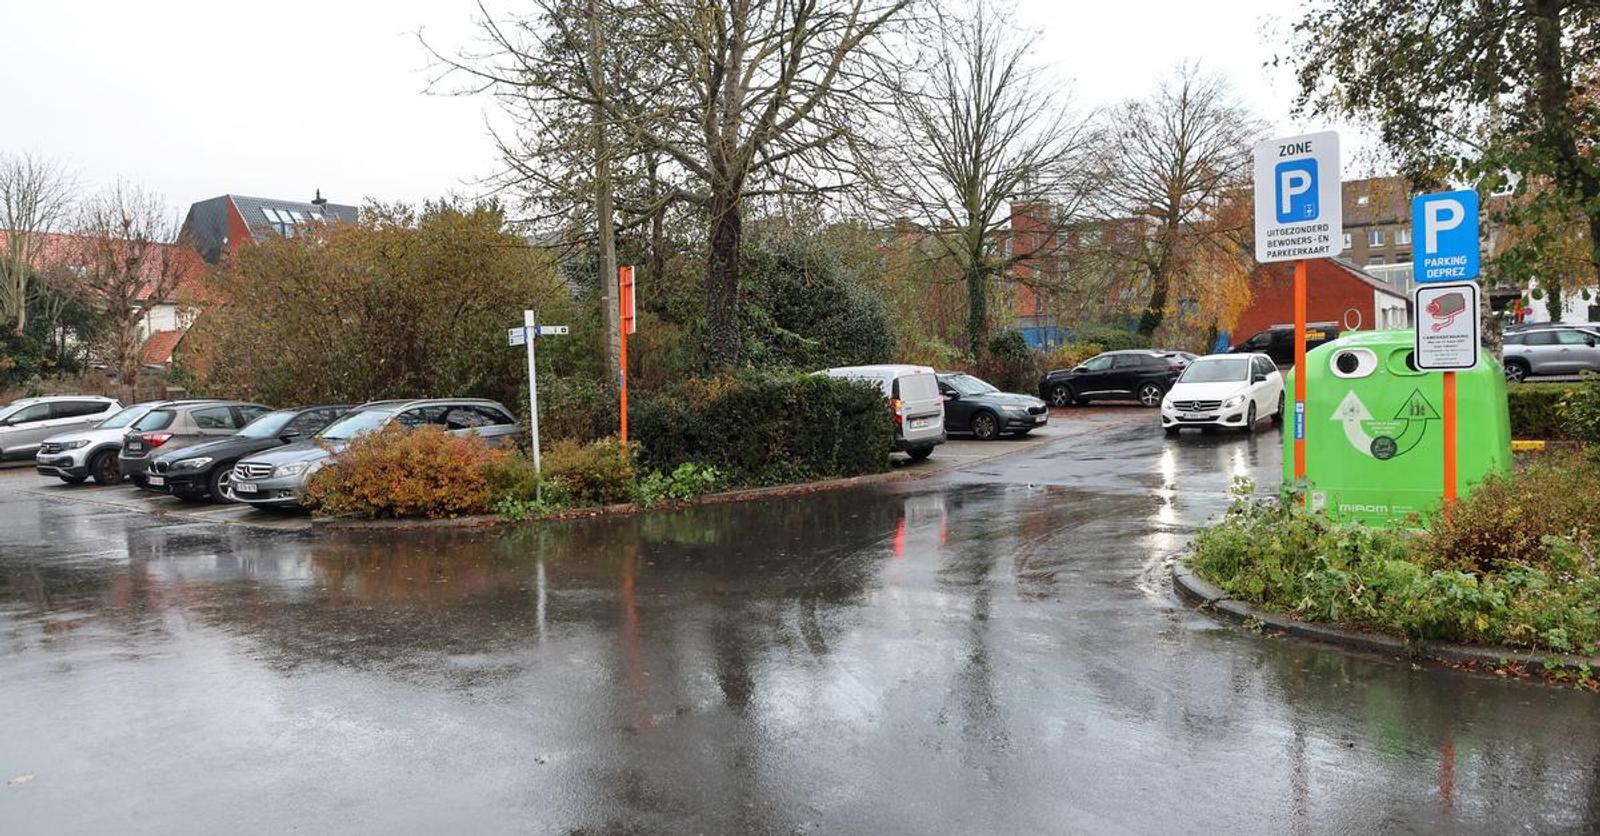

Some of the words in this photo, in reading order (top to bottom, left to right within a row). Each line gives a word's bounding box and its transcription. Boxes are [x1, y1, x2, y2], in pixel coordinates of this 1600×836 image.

[1279, 141, 1313, 157] ZONE
[1281, 169, 1312, 214] P
[1266, 223, 1329, 237] UITGEZONDERD
[1424, 199, 1465, 254] P
[1266, 245, 1331, 258] PARKEERKAART
[1424, 255, 1468, 267] PARKING
[1426, 266, 1466, 279] DEPREZ
